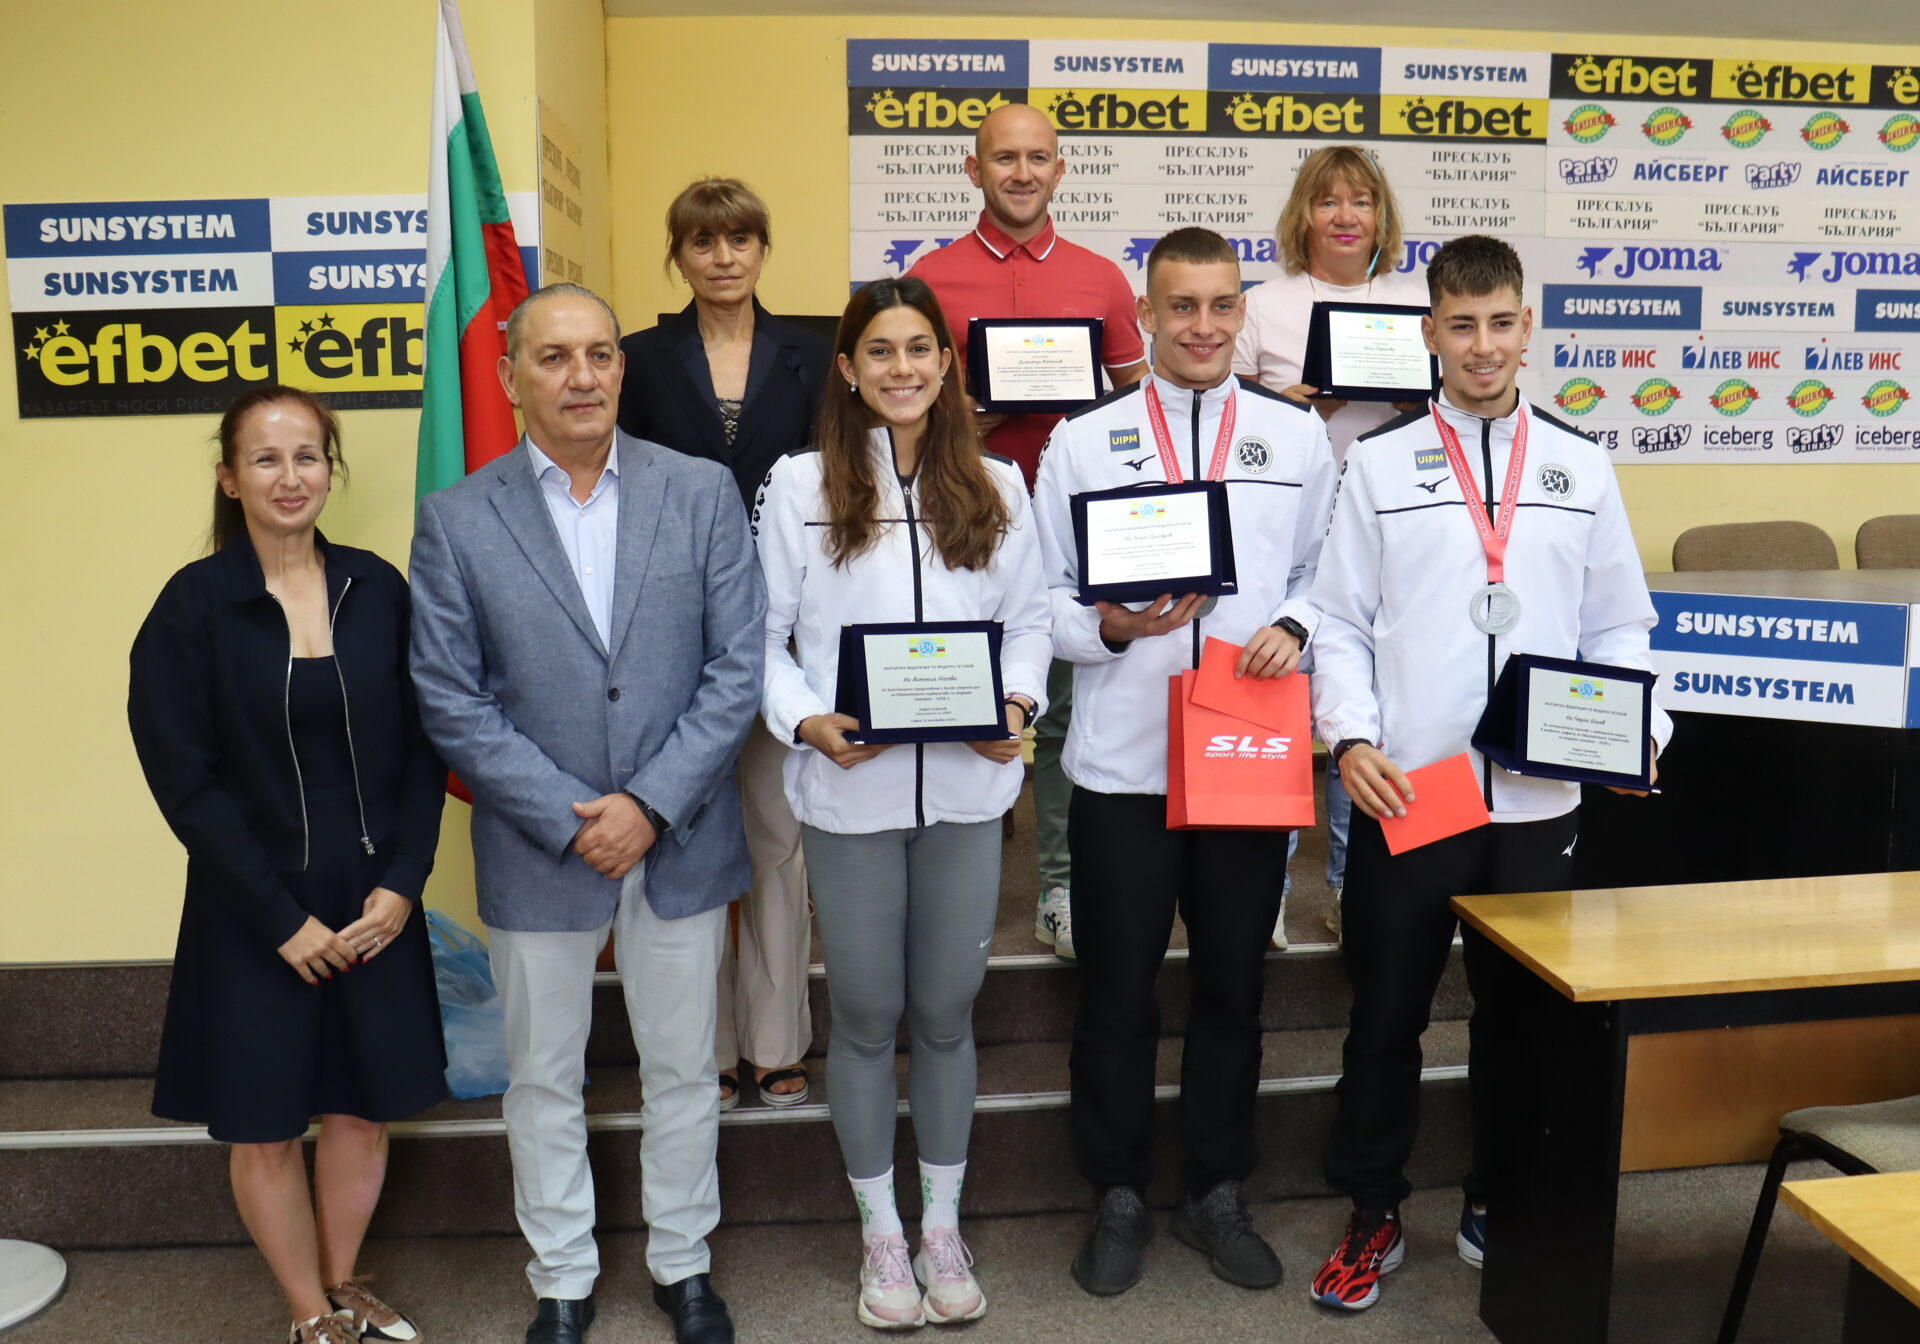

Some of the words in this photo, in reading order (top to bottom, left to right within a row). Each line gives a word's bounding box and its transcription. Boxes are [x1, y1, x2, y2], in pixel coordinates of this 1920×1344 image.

[872, 54, 1005, 72] SUNSYSTEM
[1054, 56, 1184, 74] SUNSYSTEM
[1231, 58, 1358, 79] SUNSYSTEM
[1404, 64, 1527, 83] SUNSYSTEM
[1575, 59, 1697, 97] efbet
[1737, 66, 1855, 101] efbet
[1056, 94, 1189, 130] efbet
[1233, 96, 1364, 133] efbet
[1407, 100, 1532, 137] efbet
[884, 144, 969, 157] ПРЕСКЛУБ
[1059, 145, 1113, 157] СКЛУБ
[1165, 146, 1248, 158] ПРЕСКЛУБ
[1432, 151, 1511, 164] ПРЕСКЛУБ
[1559, 156, 1617, 178] Party
[1633, 160, 1729, 182] АЙСБЕРГ
[1746, 162, 1801, 183] Party
[1816, 165, 1910, 187] АЙСБЕРГ
[884, 192, 970, 204] ПРЕСКЛУБ
[1050, 192, 1113, 204] ЕСКЛУБ
[1165, 193, 1248, 205] ПРЕСКЛУБ
[1431, 197, 1510, 210] ПРЕСКЛУБ
[1576, 199, 1653, 213] ПРЕСКЛУБ
[1053, 211, 1119, 222] ЛГАРИЯ”
[1704, 203, 1780, 217] ПРЕСКЛУБ
[1824, 207, 1897, 221] ПРЕСКЛУБ
[40, 214, 235, 243] SUNSYSTEM
[306, 210, 427, 236] SUNSYS
[1614, 246, 1722, 279] Joma
[1822, 251, 1920, 283] Joma
[44, 269, 238, 296] SUNSYSTEM
[1564, 298, 1681, 316] SUNSYSTEM
[1723, 301, 1835, 318] SUNSYSTEM
[40, 319, 269, 386] efbet
[1583, 350, 1616, 368] ЛЕВ
[1622, 350, 1656, 368] ИНС
[1709, 351, 1742, 369] ЛЕВ
[1747, 351, 1780, 369] ИНС
[1832, 352, 1863, 370] ЛЕВ
[1869, 353, 1901, 370] ИНС
[117, 398, 168, 413] НОСИ
[176, 396, 224, 411] РИСК
[1111, 434, 1138, 445] UIPM
[1632, 424, 1691, 447] Party
[1704, 424, 1773, 449] iceberg
[1787, 424, 1844, 446] Party
[1855, 424, 1920, 449] iceberg
[1639, 441, 1680, 454] DRINKS
[1793, 440, 1833, 454] DRINKS
[1417, 454, 1445, 465] UIPM
[1675, 611, 1859, 644] SUNSYSTEM
[1673, 671, 1854, 705] SUNSYSTEM
[1206, 736, 1292, 753] SLS
[1260, 752, 1288, 760] style
